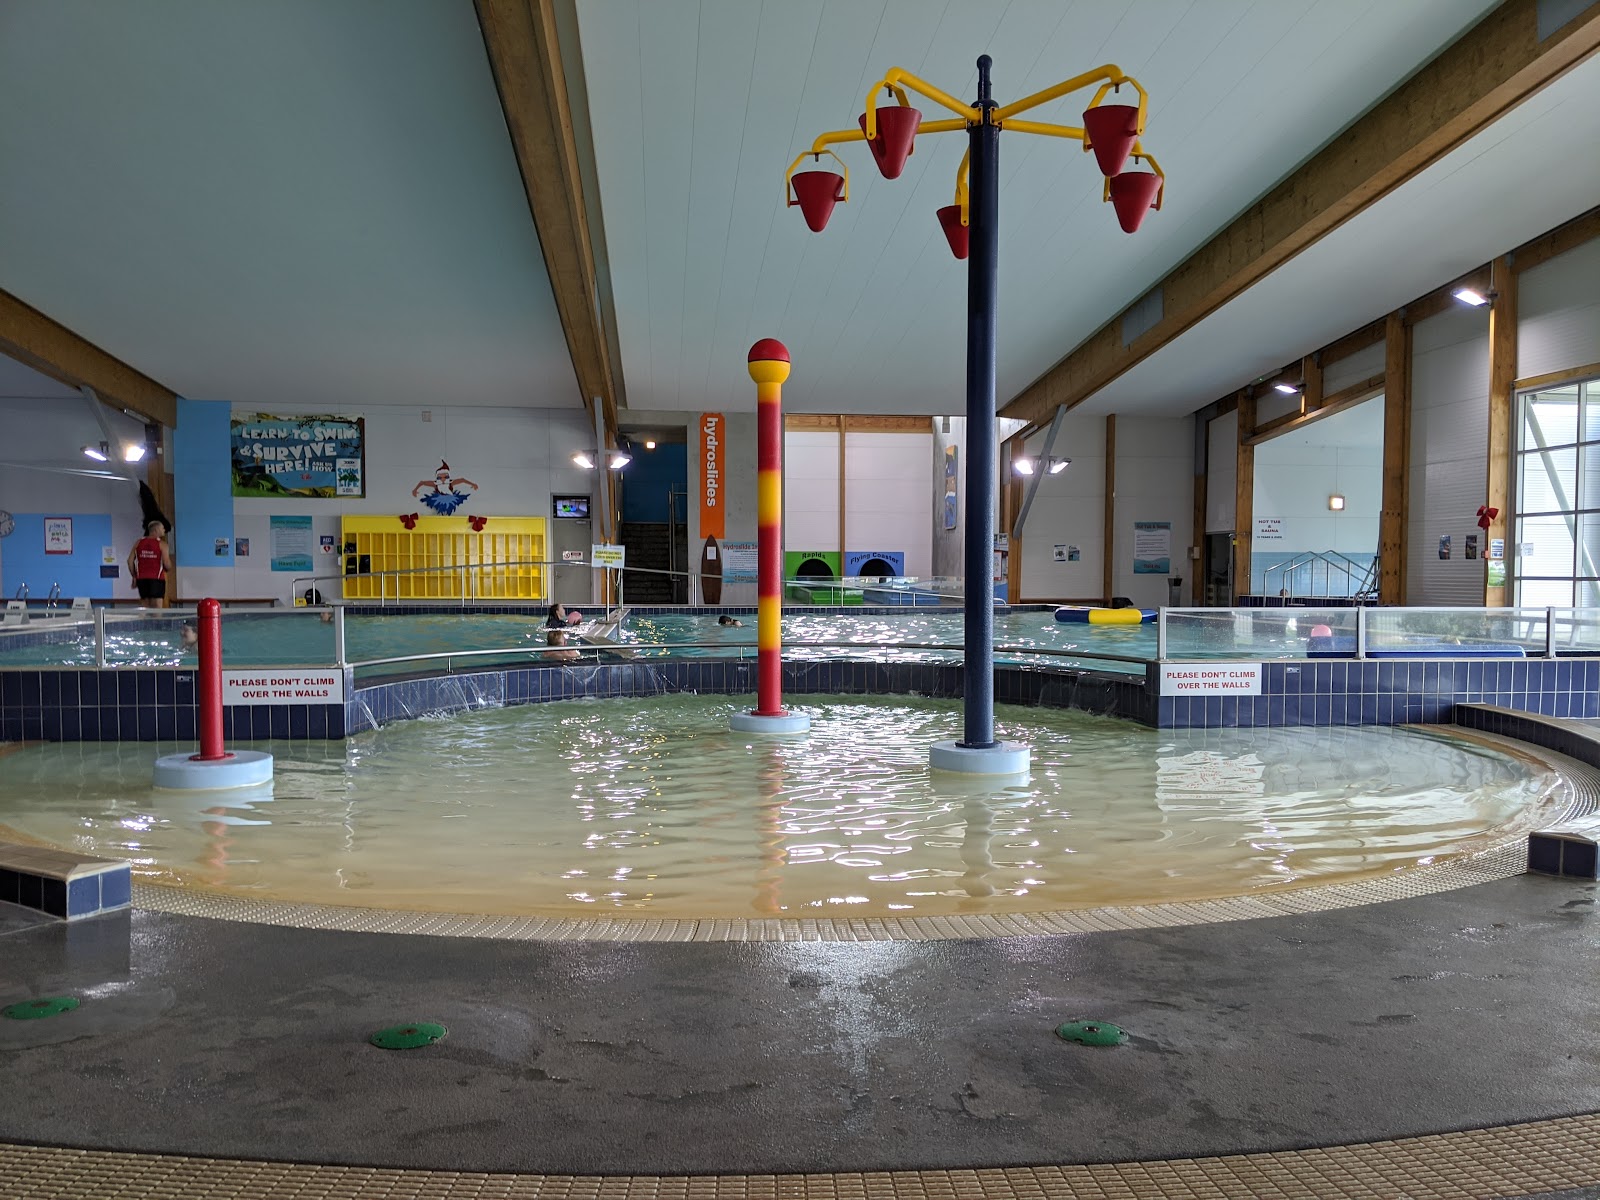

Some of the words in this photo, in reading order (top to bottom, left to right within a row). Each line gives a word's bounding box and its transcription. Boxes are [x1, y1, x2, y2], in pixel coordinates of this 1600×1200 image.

[241, 427, 287, 439] LEARN
[292, 429, 310, 440] TO
[314, 427, 357, 441] SWIM
[252, 442, 337, 461] SURVIVE
[264, 458, 310, 474] HERE!
[703, 417, 719, 507] hydroslides
[722, 543, 750, 551] Hydroslide
[850, 553, 871, 564] Flying
[872, 552, 899, 564] Coaster
[229, 679, 268, 687] PLEASE
[270, 678, 301, 686] DON'T
[303, 677, 335, 686] CLIMB
[242, 690, 270, 698] OVER
[272, 690, 292, 698] THE
[295, 689, 329, 697] WALLS
